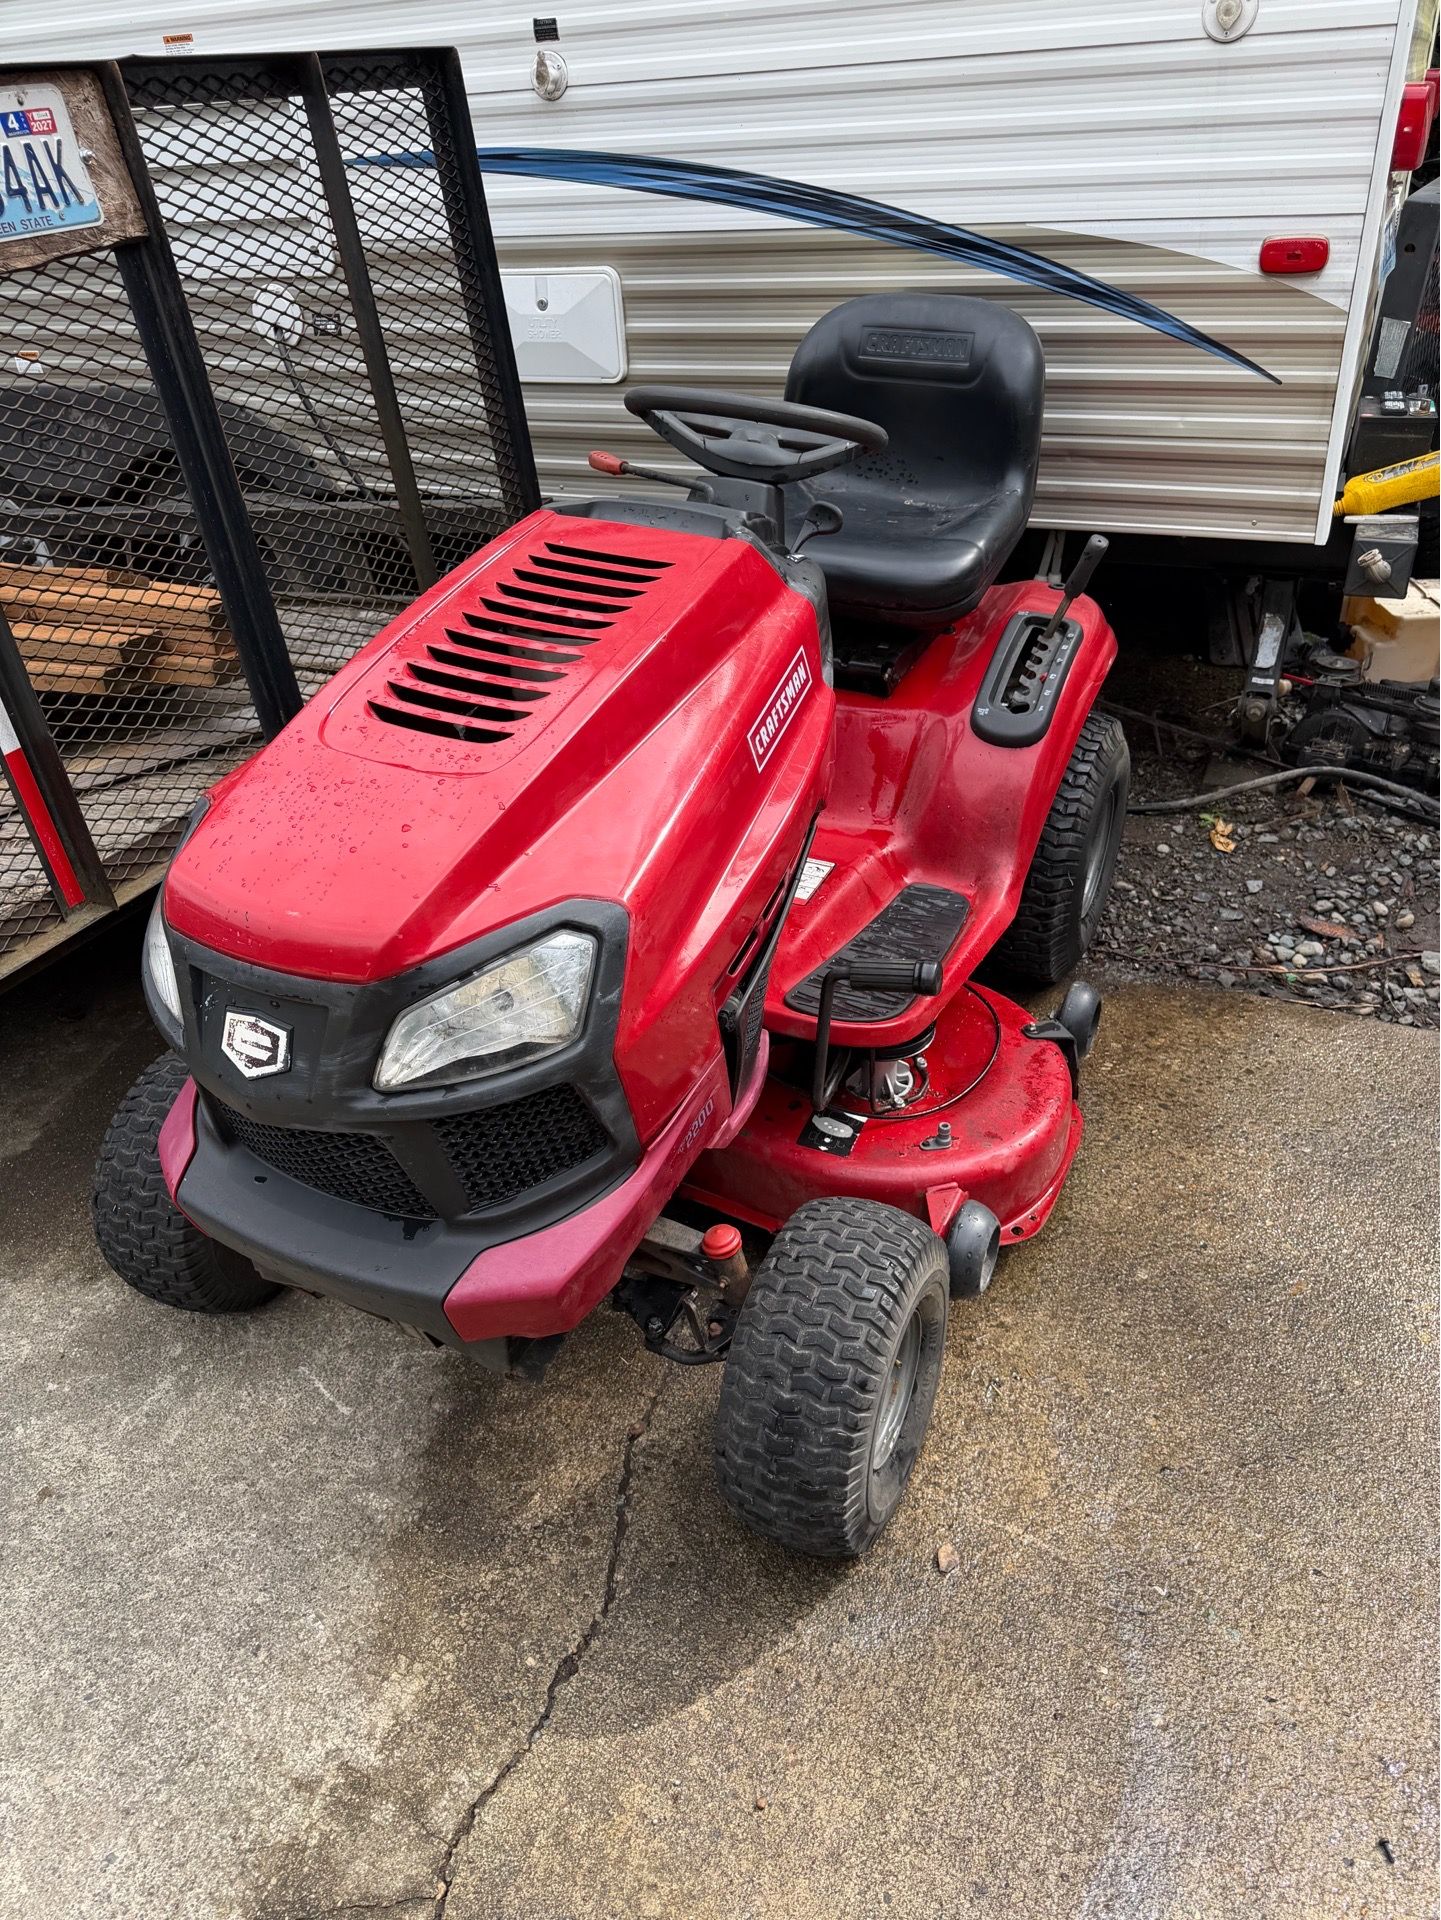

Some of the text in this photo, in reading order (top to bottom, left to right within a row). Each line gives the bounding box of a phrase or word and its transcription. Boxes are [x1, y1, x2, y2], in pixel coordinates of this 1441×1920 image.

[8, 113, 19, 130] 4
[31, 120, 53, 132] 2027
[0, 138, 84, 217] 4AK
[20, 215, 54, 231] STATE
[866, 332, 969, 358] CRAFTSMAN
[754, 661, 807, 756] CRAFTSMAN
